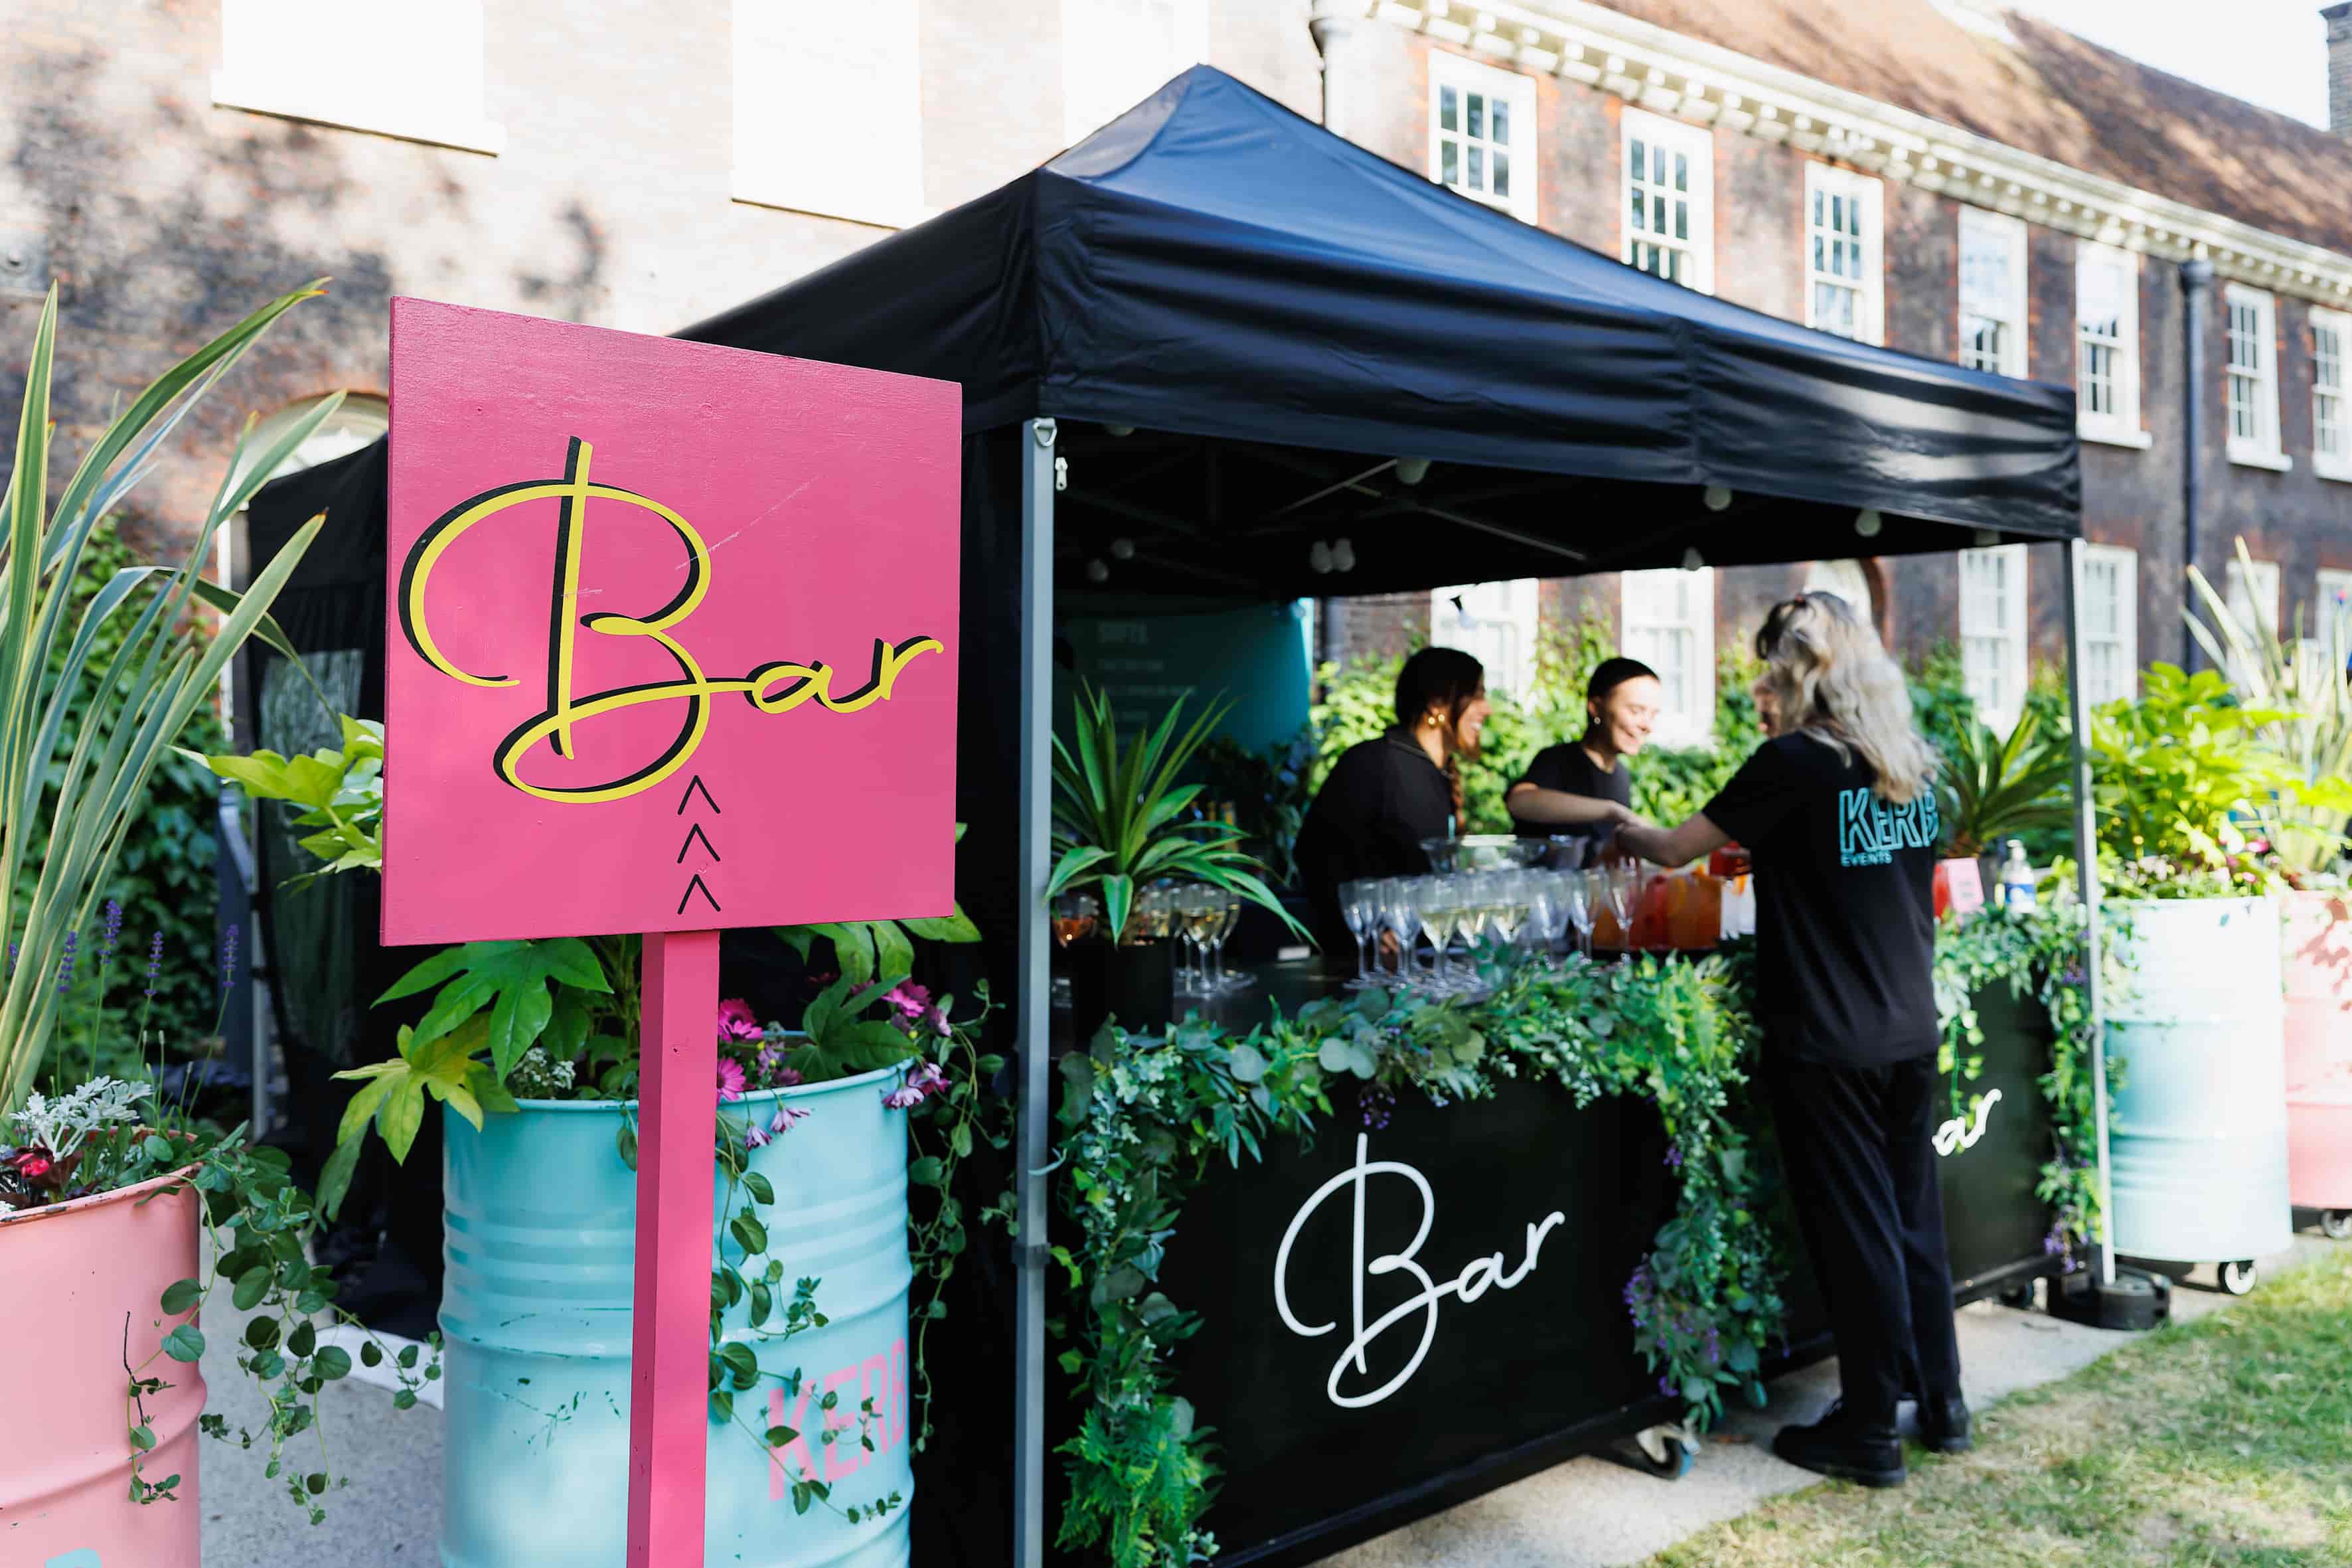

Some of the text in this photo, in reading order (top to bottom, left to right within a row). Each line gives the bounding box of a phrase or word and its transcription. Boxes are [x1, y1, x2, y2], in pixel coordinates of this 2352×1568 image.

[398, 435, 944, 804] Bar
[1838, 786, 1940, 854] KERB
[1840, 850, 1893, 866] EVENTS
[1931, 1088, 2003, 1157] ar
[1273, 1132, 1566, 1409] Bar
[768, 1338, 906, 1502] KERB
